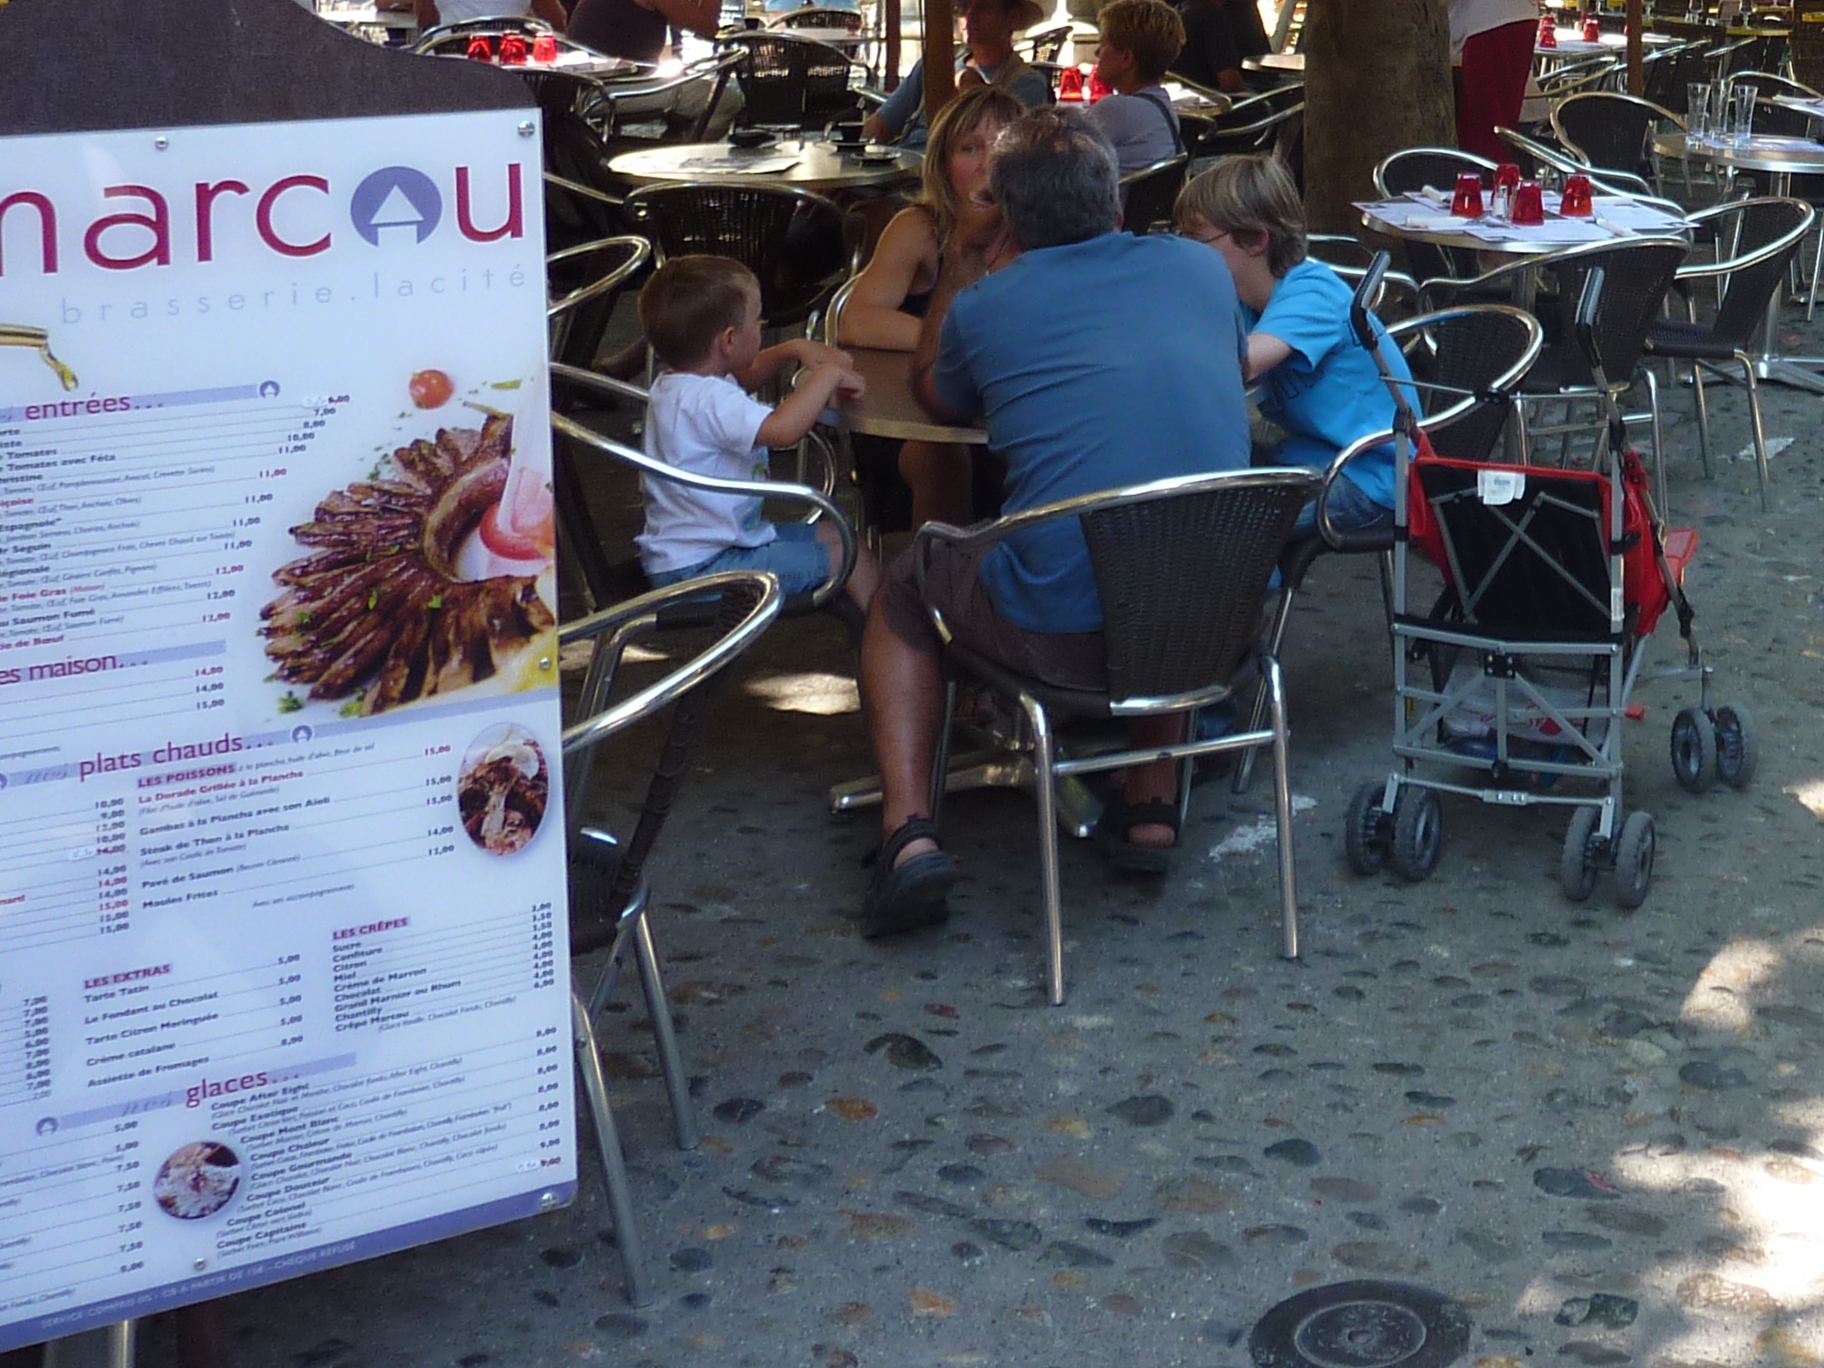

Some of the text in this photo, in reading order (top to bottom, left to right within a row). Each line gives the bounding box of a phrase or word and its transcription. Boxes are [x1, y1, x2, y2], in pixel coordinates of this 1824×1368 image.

[6, 447, 57, 460] Tomates
[6, 459, 57, 472] Tomates
[12, 591, 36, 601] Foie
[40, 587, 66, 597] Gras
[12, 606, 94, 626] Saumon Fumé
[15, 639, 28, 647] de
[80, 746, 140, 782] plats
[138, 794, 151, 804] La
[155, 787, 195, 801] Dorade
[199, 779, 235, 793] Grillée
[239, 778, 245, 787] à
[248, 776, 258, 785] la
[261, 769, 302, 783] Plancha
[424, 743, 450, 757] 15,00
[138, 763, 235, 788] LES POISSONS
[139, 820, 184, 836] Gambas
[188, 818, 193, 827] à
[197, 816, 207, 826] la
[210, 808, 252, 824] Plancha
[256, 805, 279, 816] avec
[283, 802, 301, 811] son
[425, 774, 452, 787] 15,00
[140, 794, 452, 856] Steak de Thon à la Plancha 15,00
[142, 825, 453, 889] Pavé de Saumon 14,00
[142, 888, 217, 909] Moules Frites
[332, 916, 407, 940] LES CRÊPES
[332, 940, 361, 953] Sucre
[332, 945, 382, 963] Confiture
[84, 963, 170, 989] LES EXTRAS
[333, 958, 367, 973] Citron
[333, 971, 355, 982] Miel
[84, 983, 149, 1003] Tarte Tatin
[334, 966, 426, 993] Crème de Marron
[85, 990, 217, 1025] Le Fondant au Chocolat
[335, 985, 380, 1003] Chocolat
[335, 978, 460, 1012] Grand Marnier ou Rhum
[335, 1005, 382, 1023] Chantilly
[336, 1009, 408, 1033] Crêpe Marcou
[85, 1010, 218, 1046] Tarte Citron Meringuée
[86, 1040, 175, 1067] Crème catalane
[87, 1054, 209, 1088] Assiette de Fromages
[211, 1081, 308, 1112] Coupe After Eight
[212, 1104, 297, 1132] Coupe Exotique
[240, 1114, 338, 1145] Coupe Mont Blanc
[250, 1136, 329, 1163] Coupe Chaleur
[251, 1150, 351, 1183] Coupe Gourmande
[246, 1175, 329, 1203] Coupe Douceur
[227, 1200, 305, 1228] Coupe Colonel
[216, 1220, 306, 1251] Coupe Capitaine
